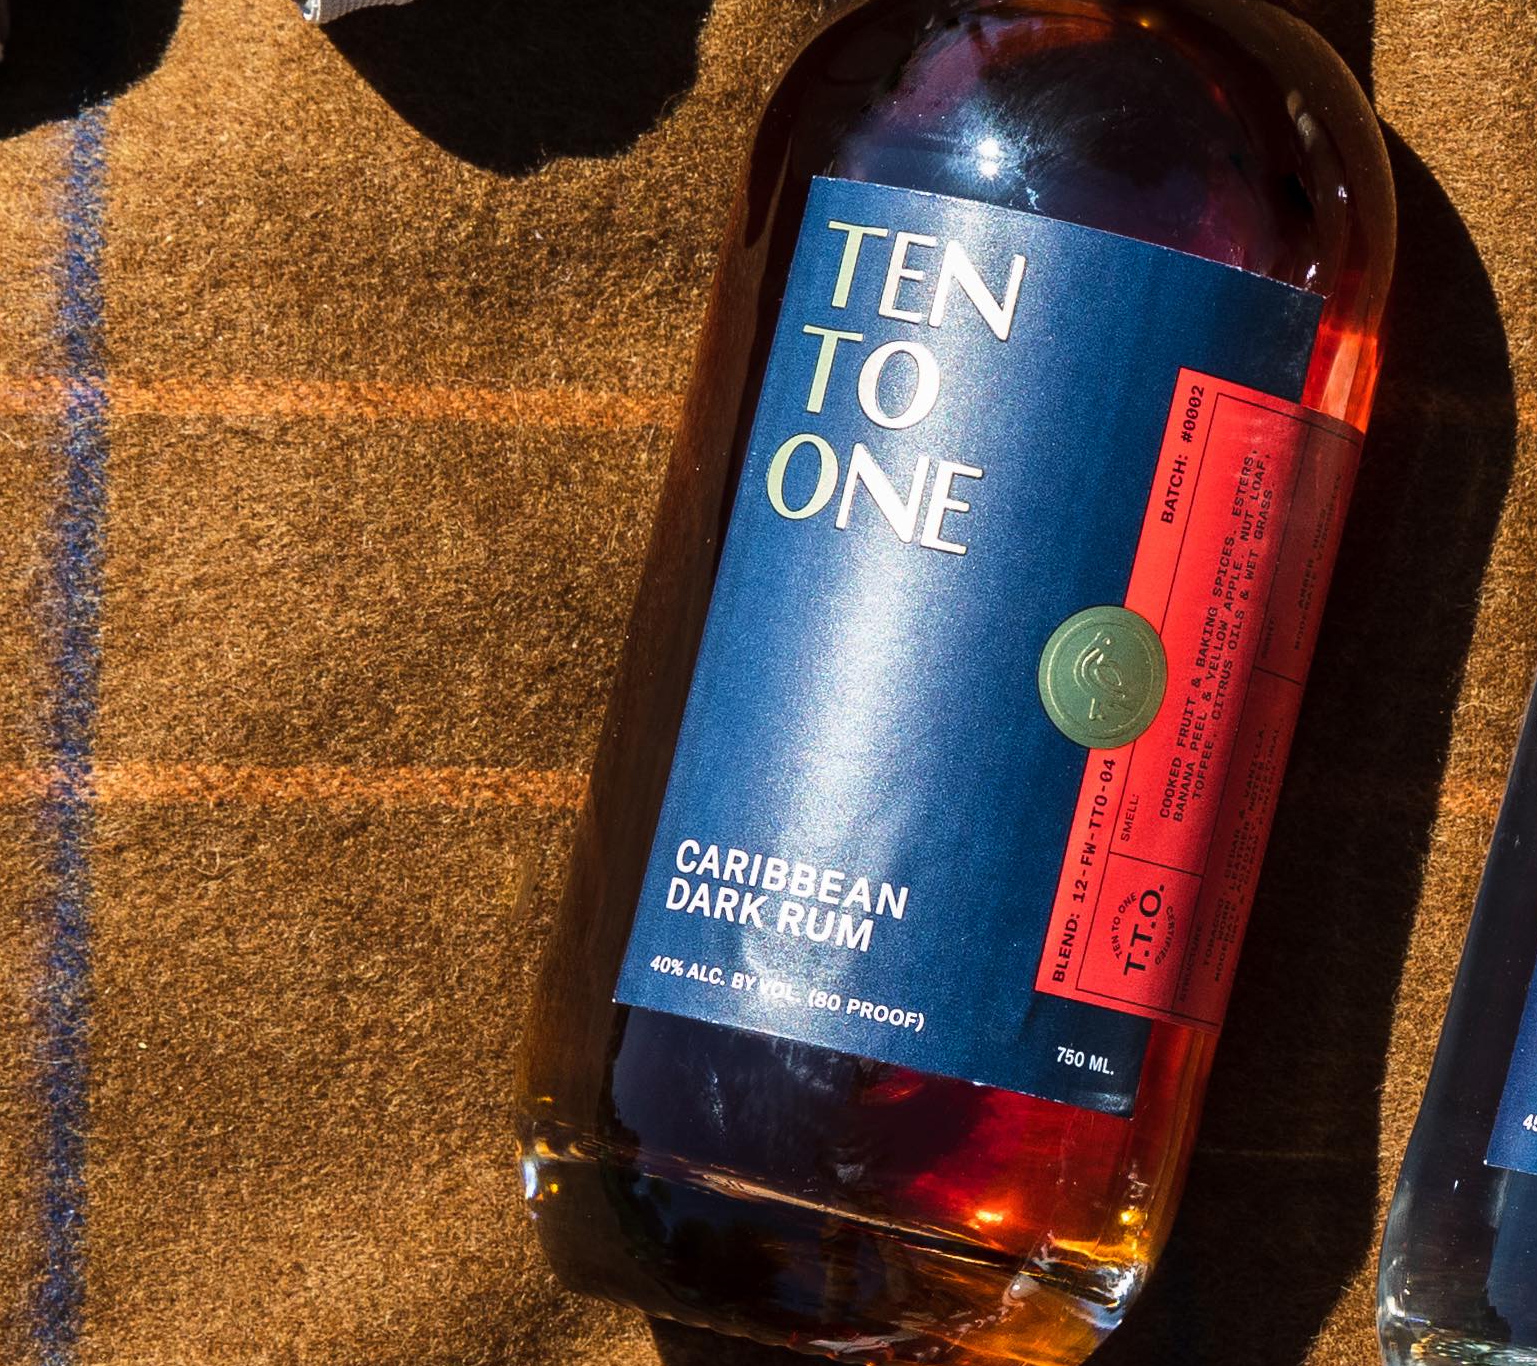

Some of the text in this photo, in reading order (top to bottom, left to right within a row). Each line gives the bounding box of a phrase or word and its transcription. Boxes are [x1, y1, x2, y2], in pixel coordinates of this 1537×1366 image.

[828, 220, 1026, 342] TEN
[803, 324, 941, 430] TO
[1160, 385, 1204, 524] BATCH: #0002
[767, 433, 984, 556] ONE
[1239, 509, 1254, 542] NUT
[1239, 590, 1250, 601] &
[1244, 549, 1259, 581] WET
[1195, 606, 1218, 668] BAKING
[1205, 619, 1228, 681] YELLOW
[1228, 609, 1245, 651] OILS
[1190, 677, 1202, 689] &
[1201, 691, 1212, 702] &
[1211, 659, 1233, 721] CITRUS
[1176, 696, 1196, 748] FRUIT
[1189, 713, 1208, 752] PEEL
[1120, 793, 1141, 842] SMELL:
[1159, 757, 1182, 819] COOKED
[1172, 762, 1196, 822] BANANA
[676, 839, 909, 920] CARIBBEAN
[1052, 759, 1116, 983] BLEND: 12-FW-TTO-04
[664, 876, 875, 953] DARK RUM
[1111, 893, 1136, 958] TEN TO ONE
[1123, 884, 1165, 975] T.T.O.
[1155, 905, 1176, 965] CERTIFIED
[649, 954, 686, 978] 40%
[685, 962, 728, 987] ALC.
[730, 971, 758, 993] BY
[808, 987, 843, 1012] (80
[845, 997, 926, 1034] PROOF)
[1056, 1045, 1115, 1076] 750 ML.
